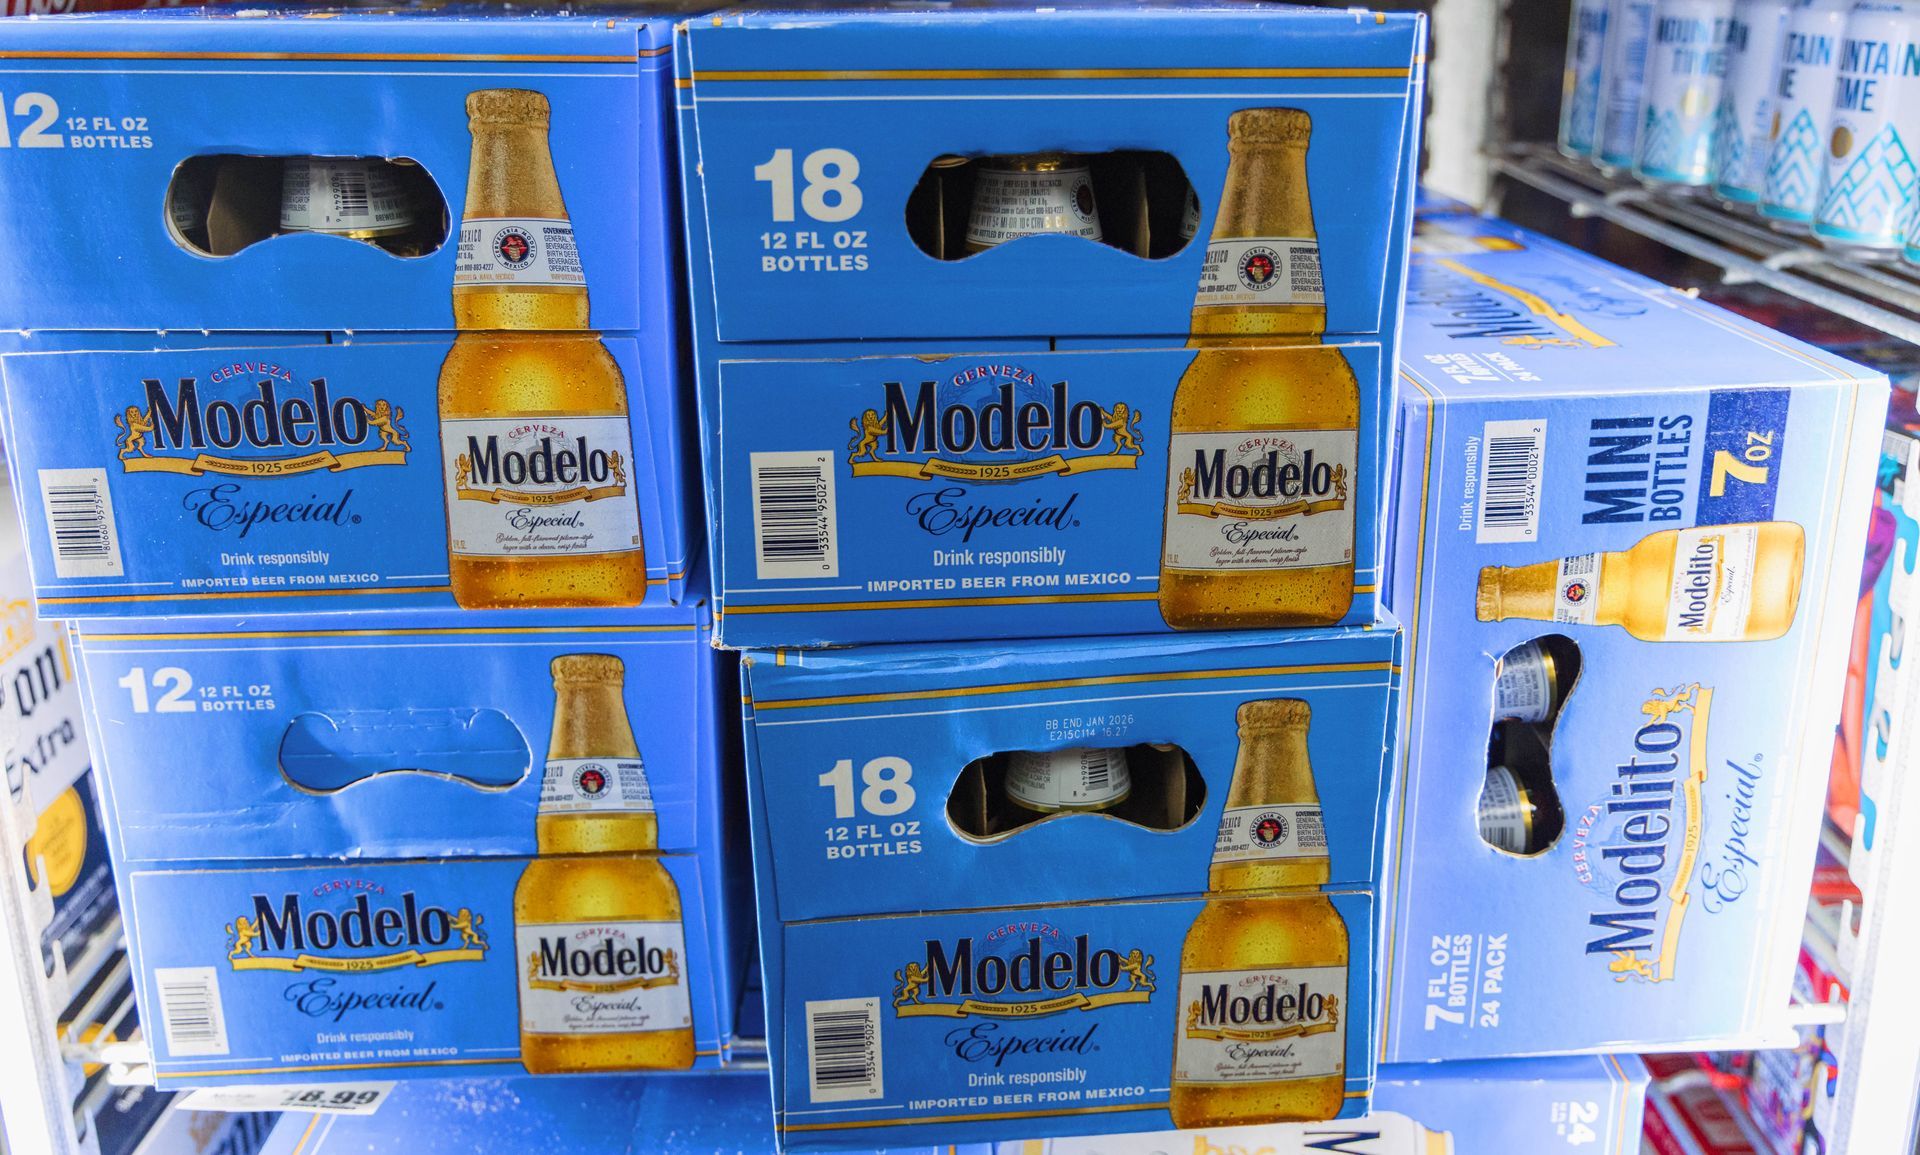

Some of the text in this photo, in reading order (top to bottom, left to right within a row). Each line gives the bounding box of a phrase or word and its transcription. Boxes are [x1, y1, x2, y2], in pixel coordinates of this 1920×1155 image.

[66, 117, 149, 131] 12 FL OZ
[71, 136, 153, 149] BOTTLES
[753, 146, 864, 223] 18
[760, 230, 868, 250] 12 FL OZ
[761, 254, 869, 272] BOTTLES
[211, 361, 294, 384] CERVEZA
[953, 365, 1036, 387] CERVEZA
[140, 377, 370, 451] Modelo
[882, 380, 1104, 455] Modelo
[508, 425, 565, 439] CERVEZA
[1237, 438, 1294, 453] CERVEZA
[251, 462, 283, 474] 1925
[467, 435, 609, 485] Modelo
[979, 465, 1011, 478] 1925
[1193, 449, 1332, 499] Modelo
[1528, 447, 1539, 479] 00021
[1581, 416, 1655, 525] MINI
[1648, 413, 1693, 522] BOTTLES
[1709, 450, 1770, 497] 7
[1744, 431, 1774, 462] OZ
[816, 476, 828, 513] 95027
[1459, 436, 1480, 531] Drink responsibly
[94, 493, 105, 521] 95757
[1250, 508, 1272, 516] 1925
[1524, 485, 1535, 516] 33544
[100, 523, 112, 552] 80660
[818, 515, 831, 551] 33544
[221, 550, 330, 566] Drink responsibly
[933, 547, 1067, 567] Drink responsibly
[181, 573, 380, 589] IMPORTED BEER FROM MEXICO
[867, 571, 1132, 592] IMPORTED BEER FROM MEXICO
[1678, 543, 1714, 630] Modelito
[118, 667, 197, 713] 12
[199, 685, 272, 698] 12 FL OZ
[202, 699, 276, 712] BOTTLES
[1063, 718, 1082, 729] END
[1086, 716, 1105, 727] JAN
[1109, 714, 1134, 726] 2026
[818, 756, 917, 819] 18
[825, 821, 921, 841] 12 FL OZ
[1585, 721, 1683, 956] Modelito
[1685, 823, 1698, 852] 1925
[826, 840, 923, 860] BOTTLES
[312, 879, 386, 898] CERVEZA
[251, 890, 451, 952] Modelo
[987, 922, 1060, 942] CERVEZA
[346, 960, 374, 971] 1925
[539, 936, 664, 977] Modelo
[925, 933, 1121, 998] Modelo
[1448, 934, 1473, 1007] BOTTLES
[1424, 934, 1465, 1031] 7 FL OZ
[1480, 934, 1509, 1028] 24 PACK
[1010, 1003, 1038, 1015] 1925
[1200, 982, 1324, 1025] Modelo
[316, 1030, 415, 1044] Drink responsibly
[864, 1018, 875, 1048] 95027
[280, 1046, 459, 1064] IMPORTED BEER FROM MEXICO
[866, 1050, 876, 1079] 33544
[968, 1068, 1088, 1088] Drink responsibly
[908, 1086, 1146, 1110] IMPORTED BEER FROM MEXICO
[1567, 1101, 1599, 1146] 24
